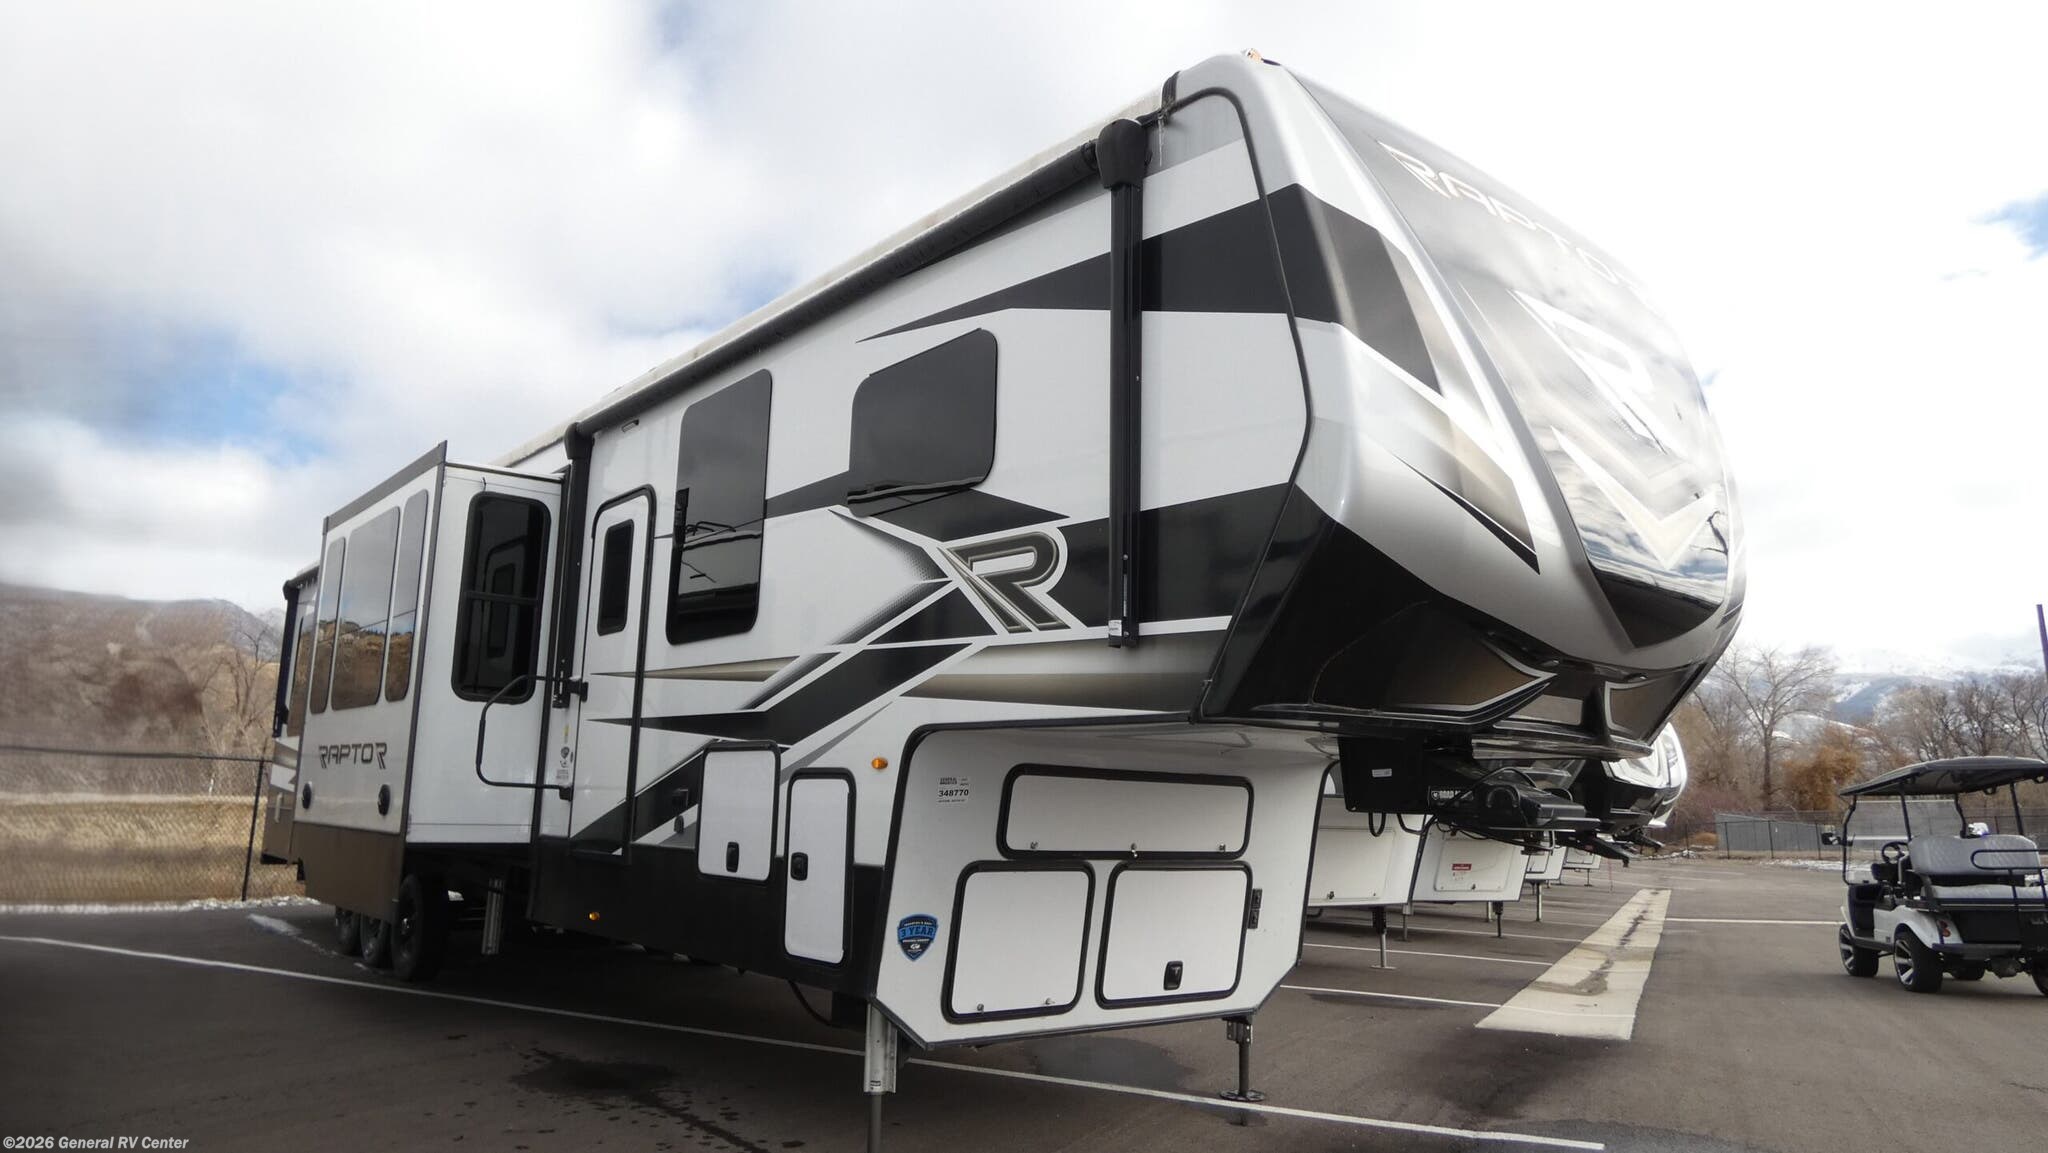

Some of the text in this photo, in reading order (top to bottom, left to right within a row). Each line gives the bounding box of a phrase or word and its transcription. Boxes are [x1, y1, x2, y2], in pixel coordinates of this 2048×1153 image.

[319, 742, 387, 769] RAPTOR
[938, 789, 969, 797] 348770
[909, 926, 934, 936] YEAR
